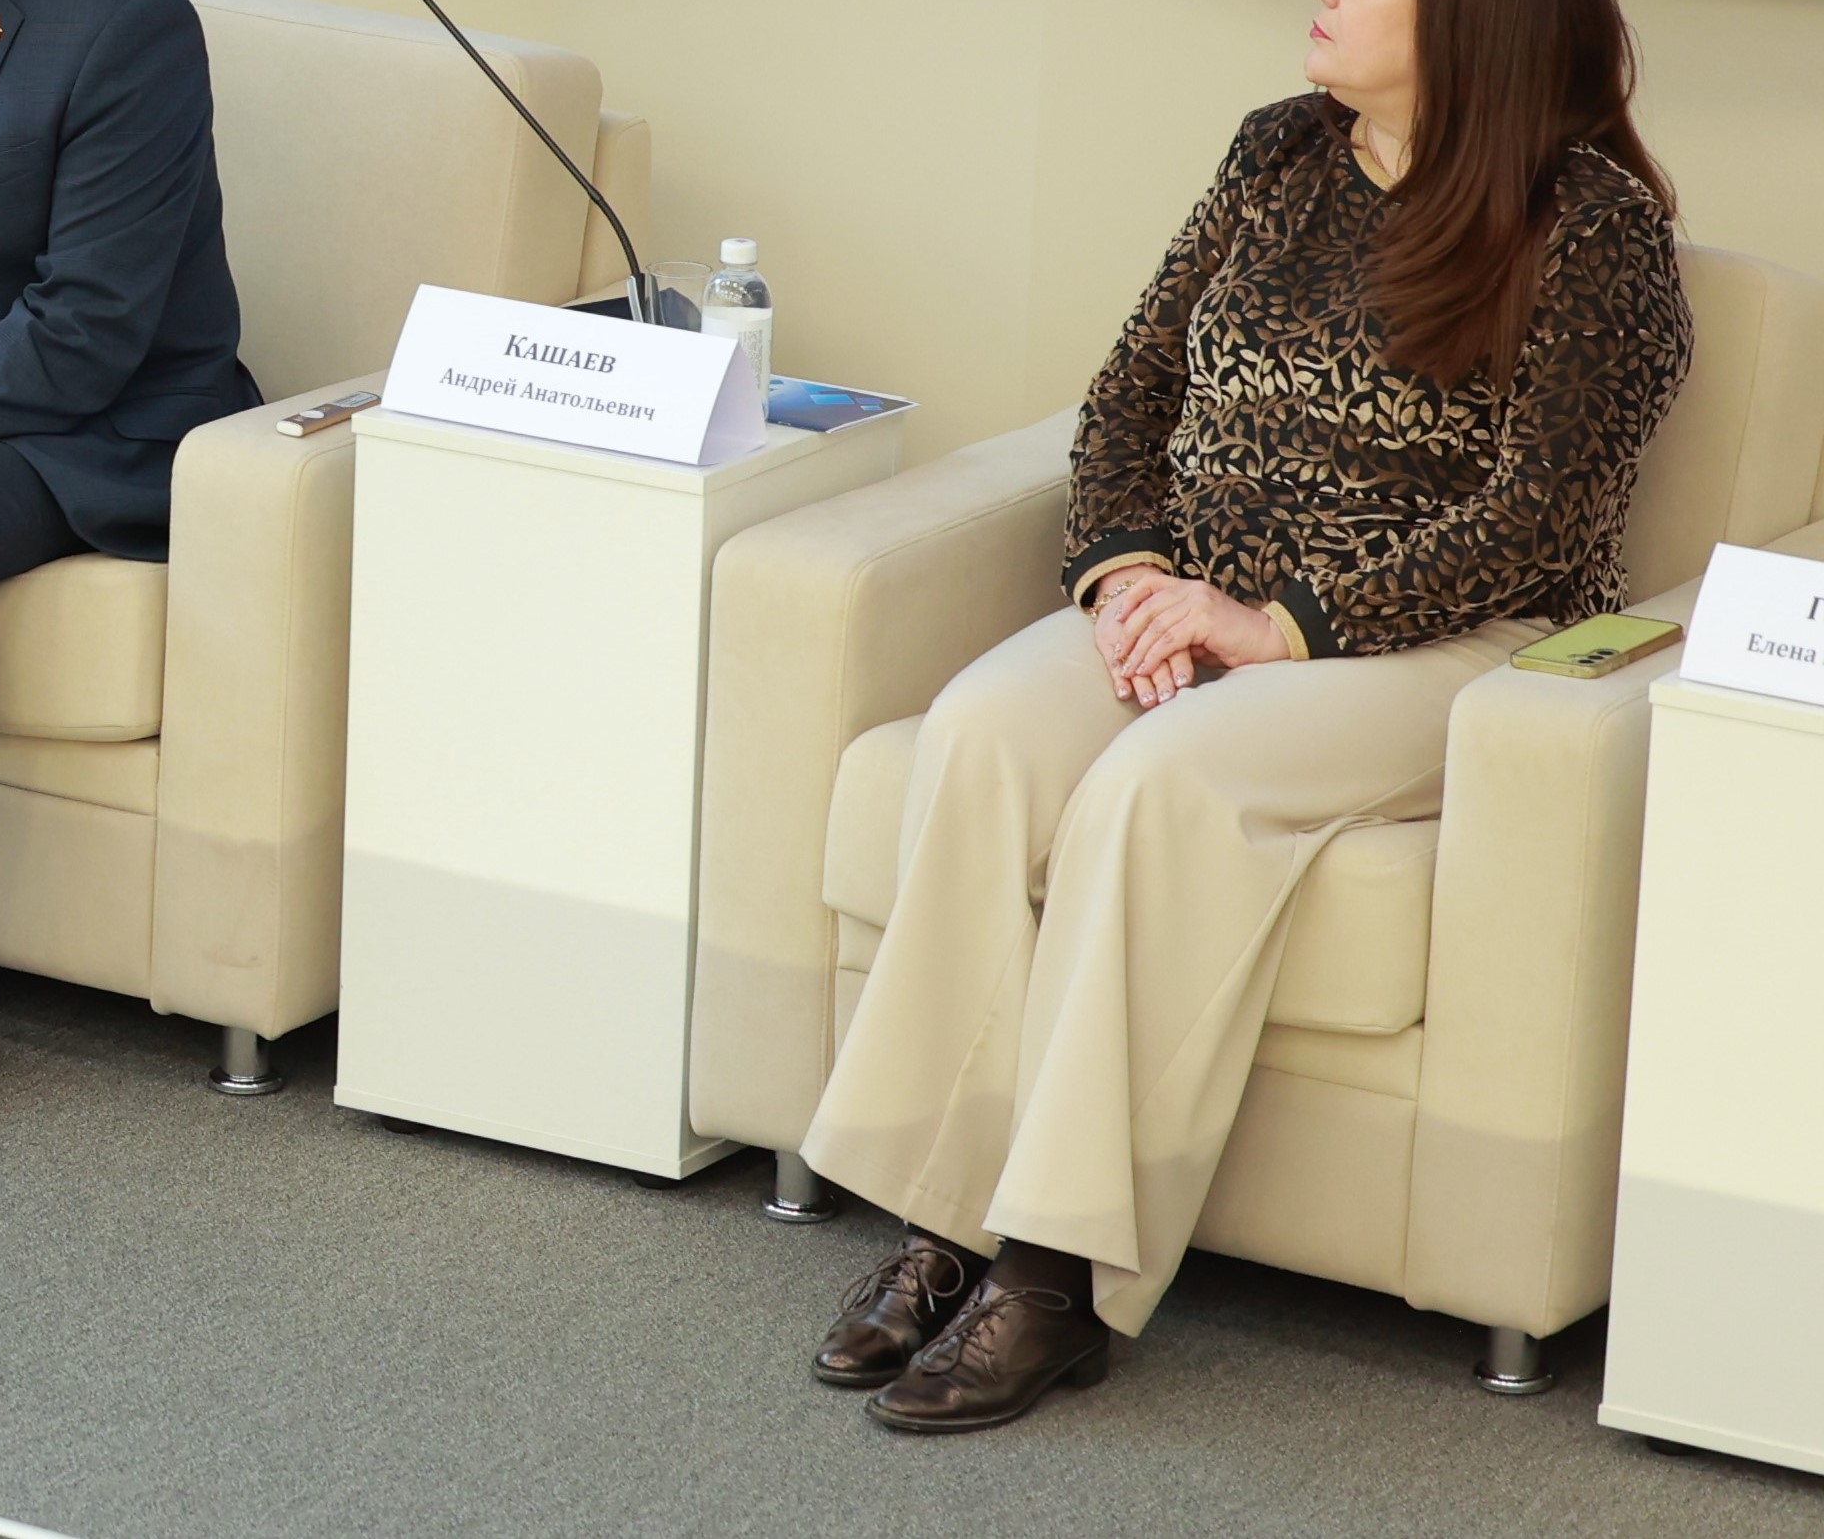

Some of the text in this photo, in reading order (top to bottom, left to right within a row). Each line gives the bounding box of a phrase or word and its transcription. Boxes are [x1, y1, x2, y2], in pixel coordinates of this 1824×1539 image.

[503, 333, 617, 374] КАШАЕВ
[438, 366, 656, 421] Андрей Анатольевич
[1746, 632, 1817, 664] Елена
